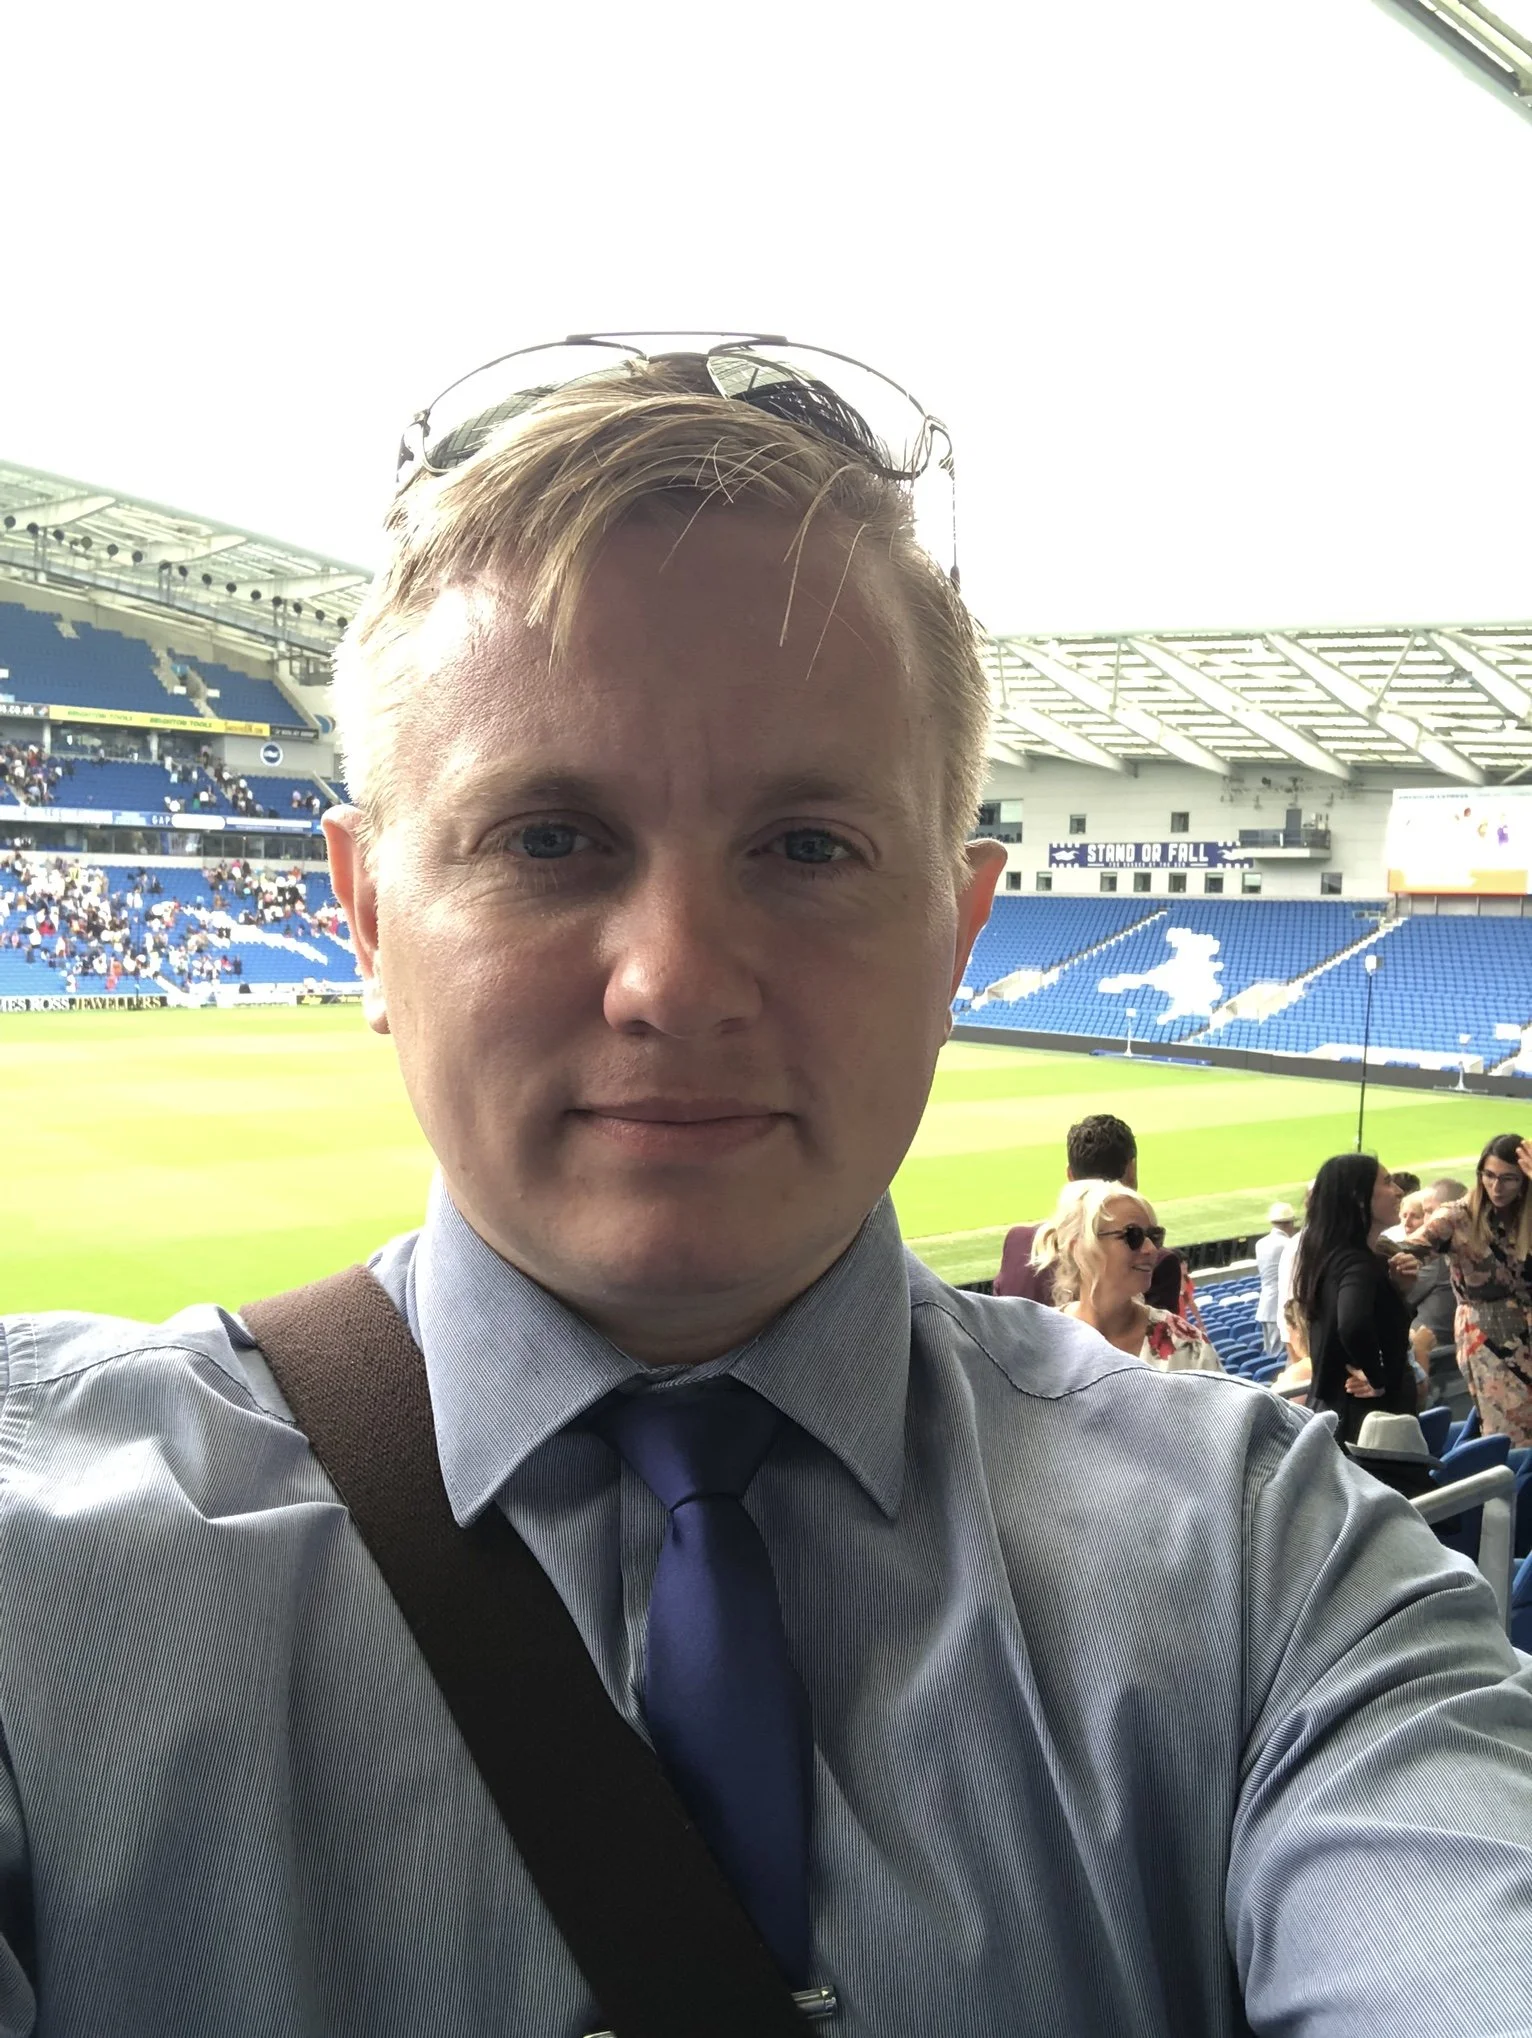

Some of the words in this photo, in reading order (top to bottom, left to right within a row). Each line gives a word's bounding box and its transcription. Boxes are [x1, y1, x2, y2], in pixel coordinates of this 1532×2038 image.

[1087, 843, 1136, 863] STAND
[1141, 843, 1162, 863] OR
[1168, 843, 1209, 862] FALL
[71, 996, 161, 1011] JEWELLERS
